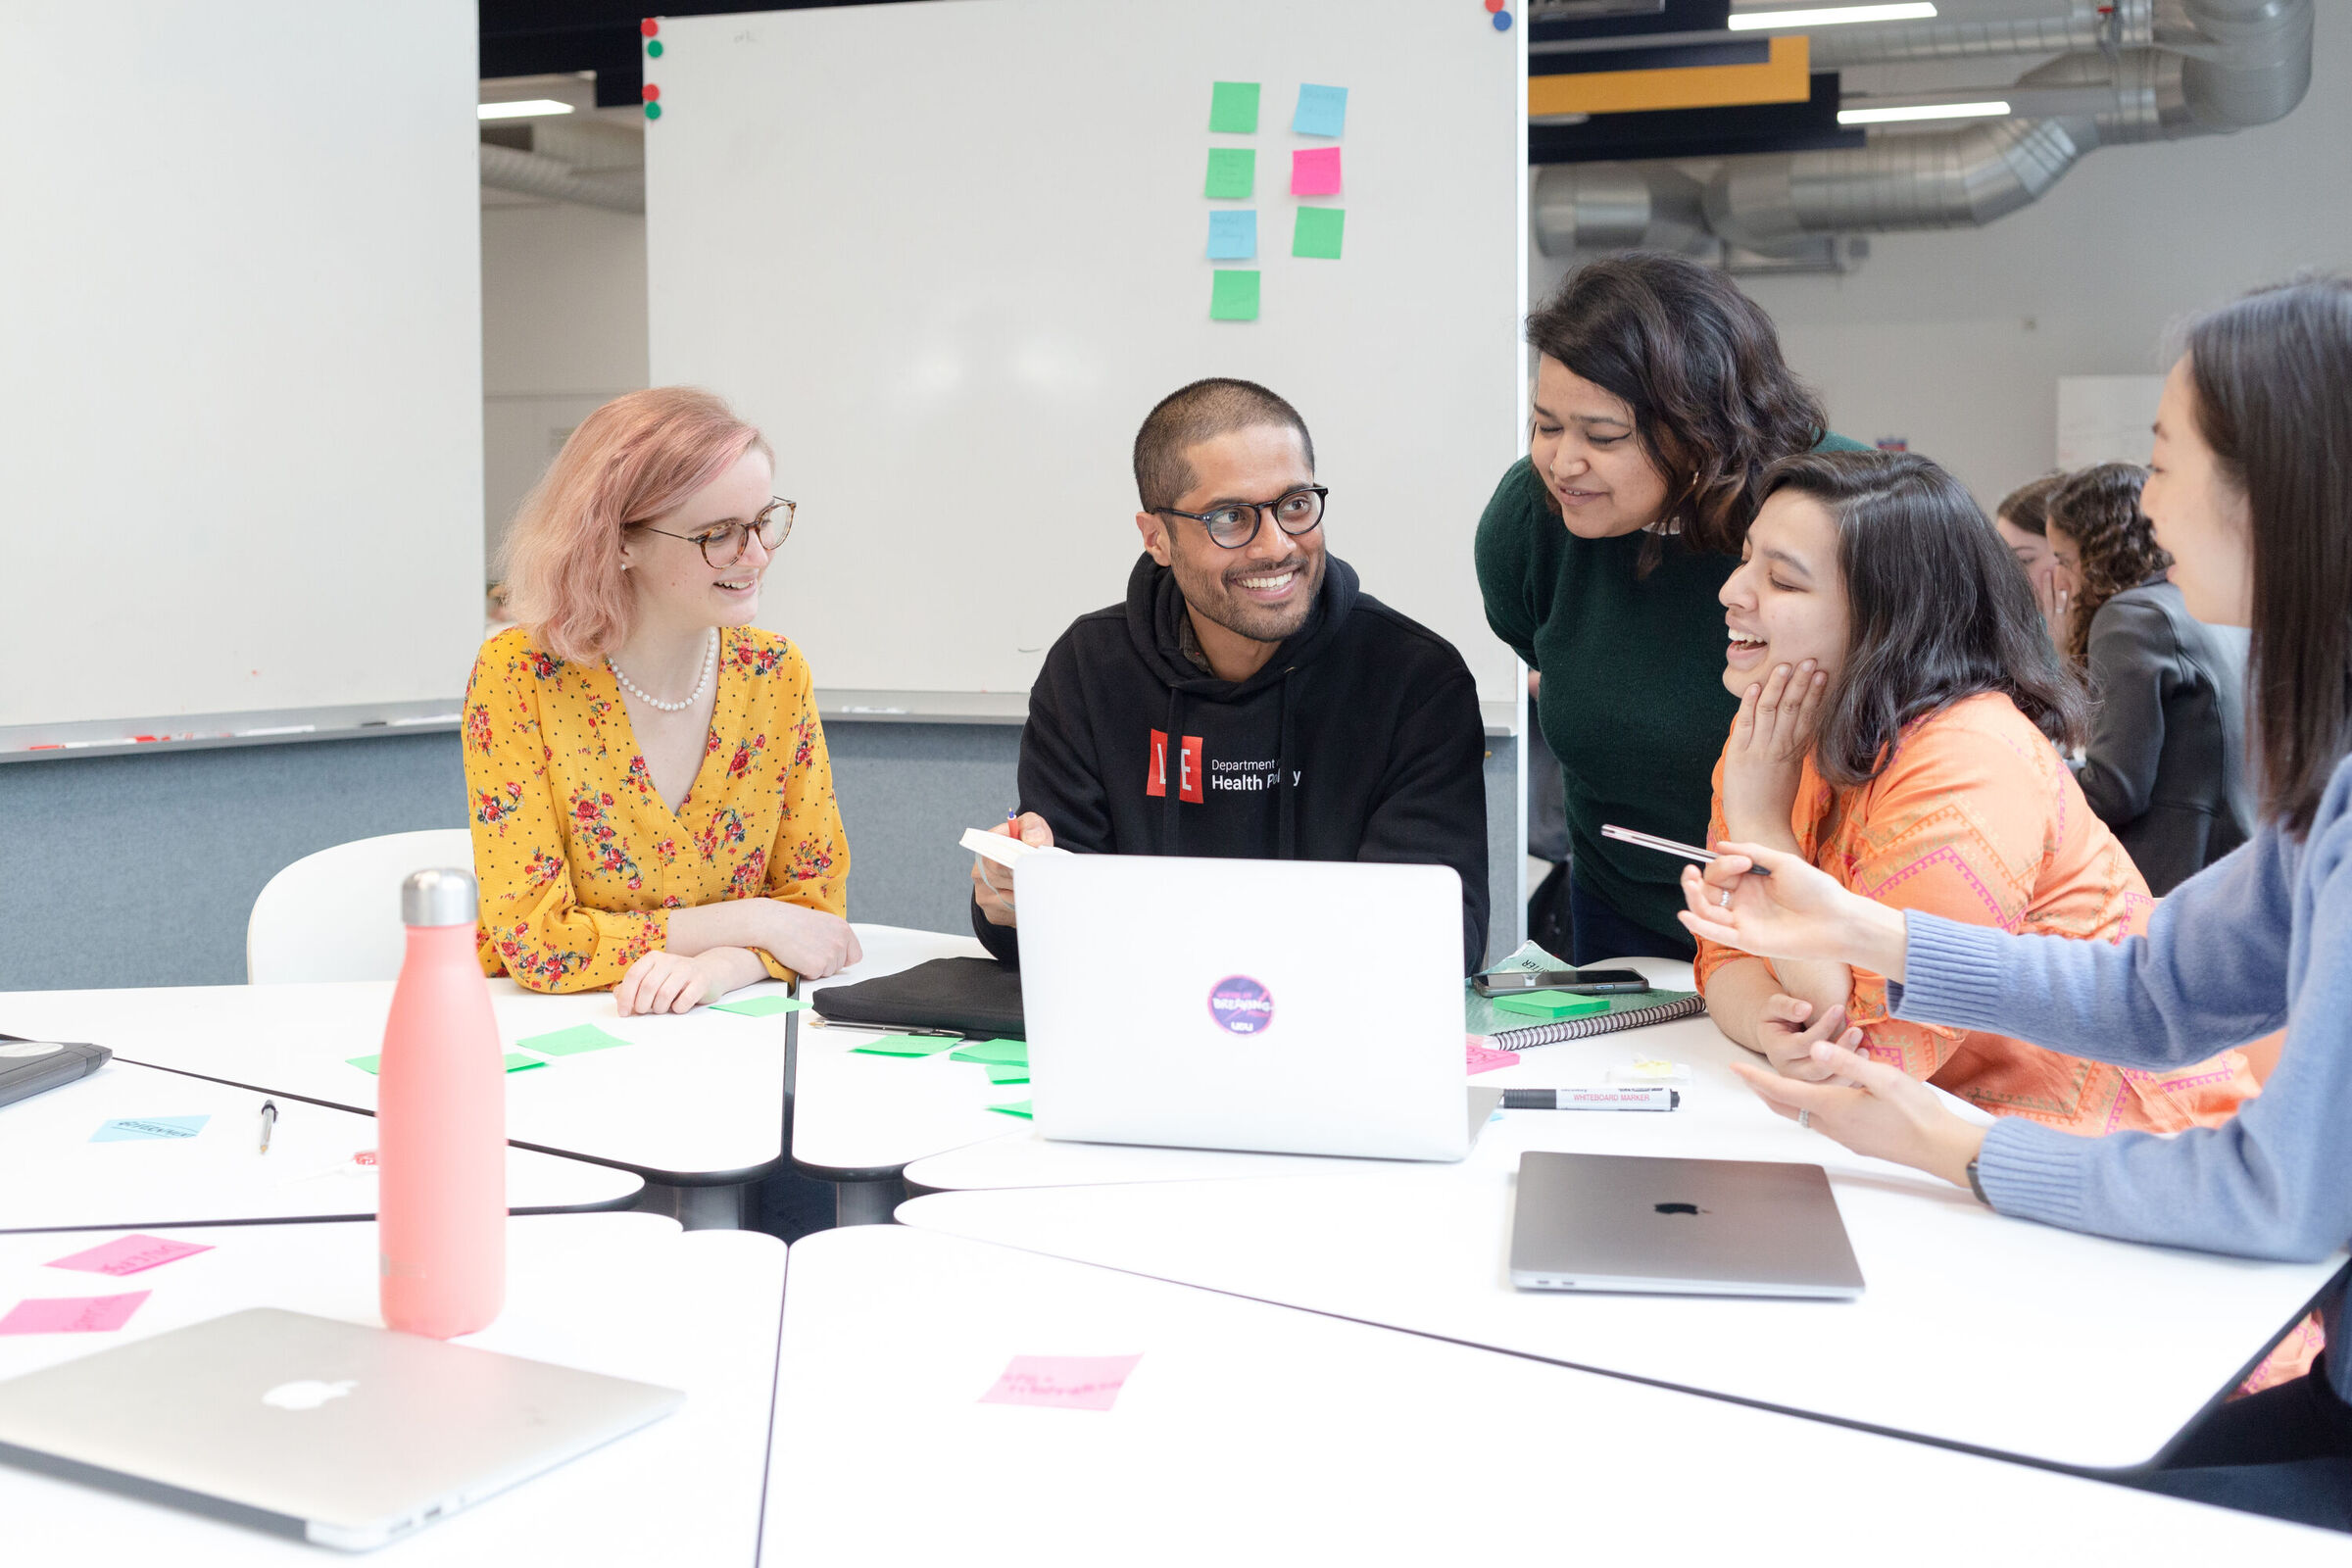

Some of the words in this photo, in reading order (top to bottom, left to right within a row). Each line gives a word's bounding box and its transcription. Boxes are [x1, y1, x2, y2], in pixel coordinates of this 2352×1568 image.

[1157, 743, 1192, 791] LE
[1211, 759, 1275, 772] Department
[1211, 774, 1263, 790] Health
[1267, 768, 1301, 788] Poly
